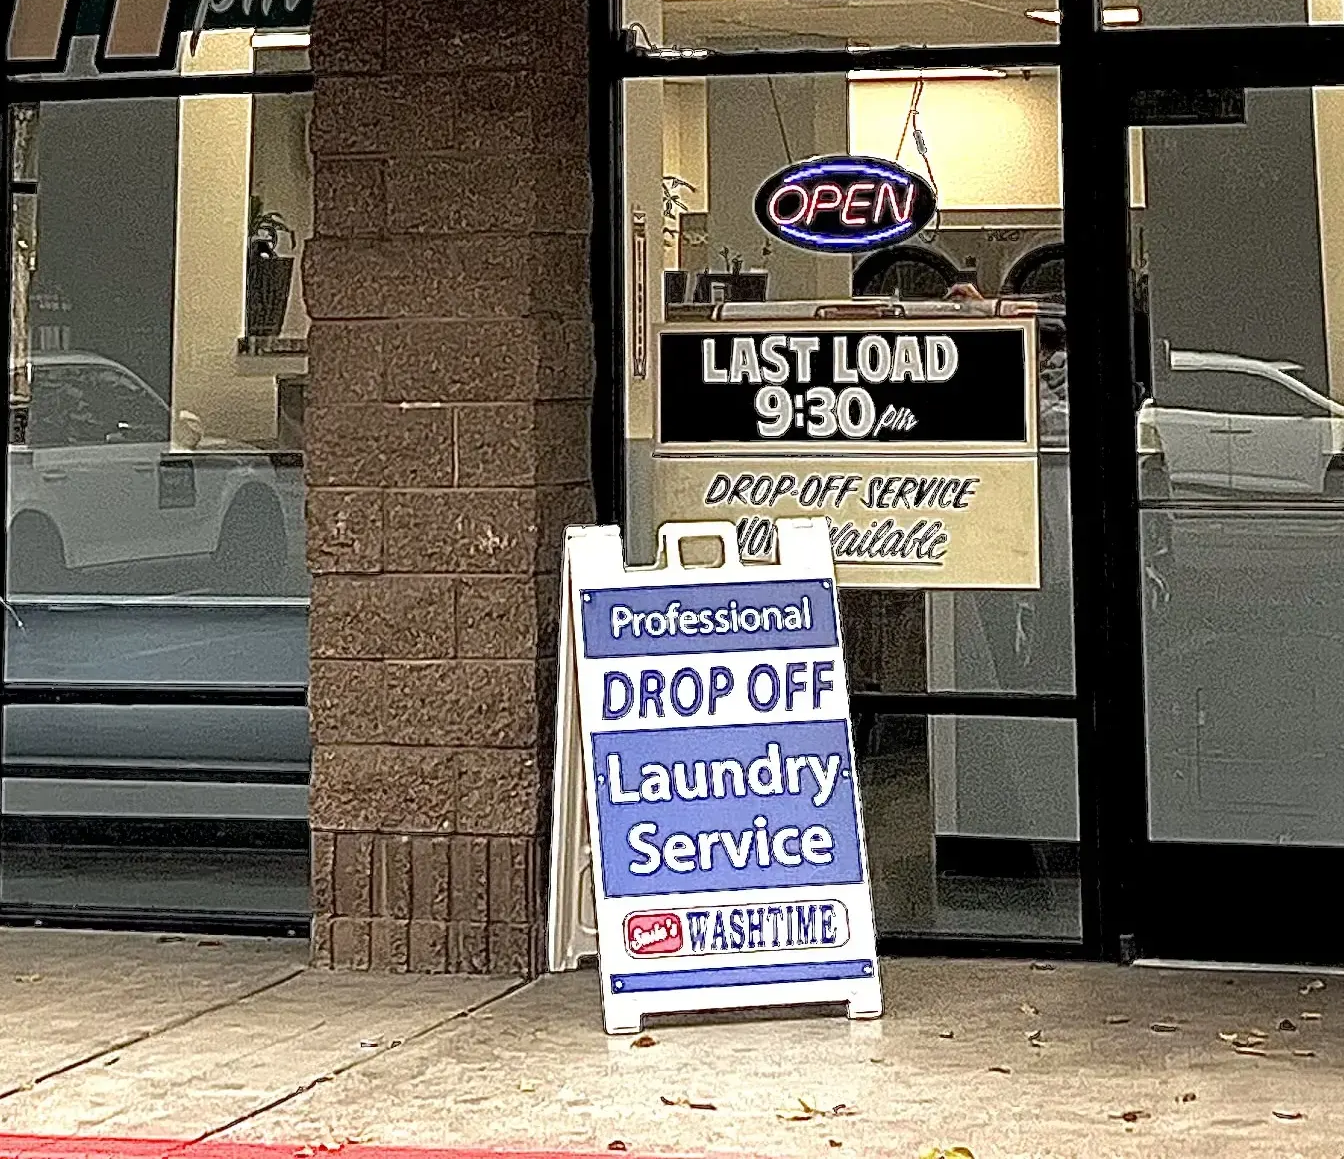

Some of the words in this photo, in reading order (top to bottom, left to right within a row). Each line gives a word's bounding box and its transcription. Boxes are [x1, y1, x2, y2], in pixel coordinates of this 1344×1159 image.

[767, 182, 916, 227] OPEN
[702, 335, 820, 384] LAST
[833, 335, 958, 384] LOAD
[755, 384, 876, 438] 9:30
[873, 404, 919, 437] pm
[705, 474, 862, 508] DROP-OFF
[861, 476, 980, 510] SERVICE
[829, 518, 948, 560] vailable
[611, 596, 812, 639] Professional
[602, 666, 735, 720] DROP
[747, 660, 835, 713] OFF
[606, 741, 842, 807] Laundry
[627, 814, 835, 876] Service
[686, 904, 838, 952] WASHTIME
